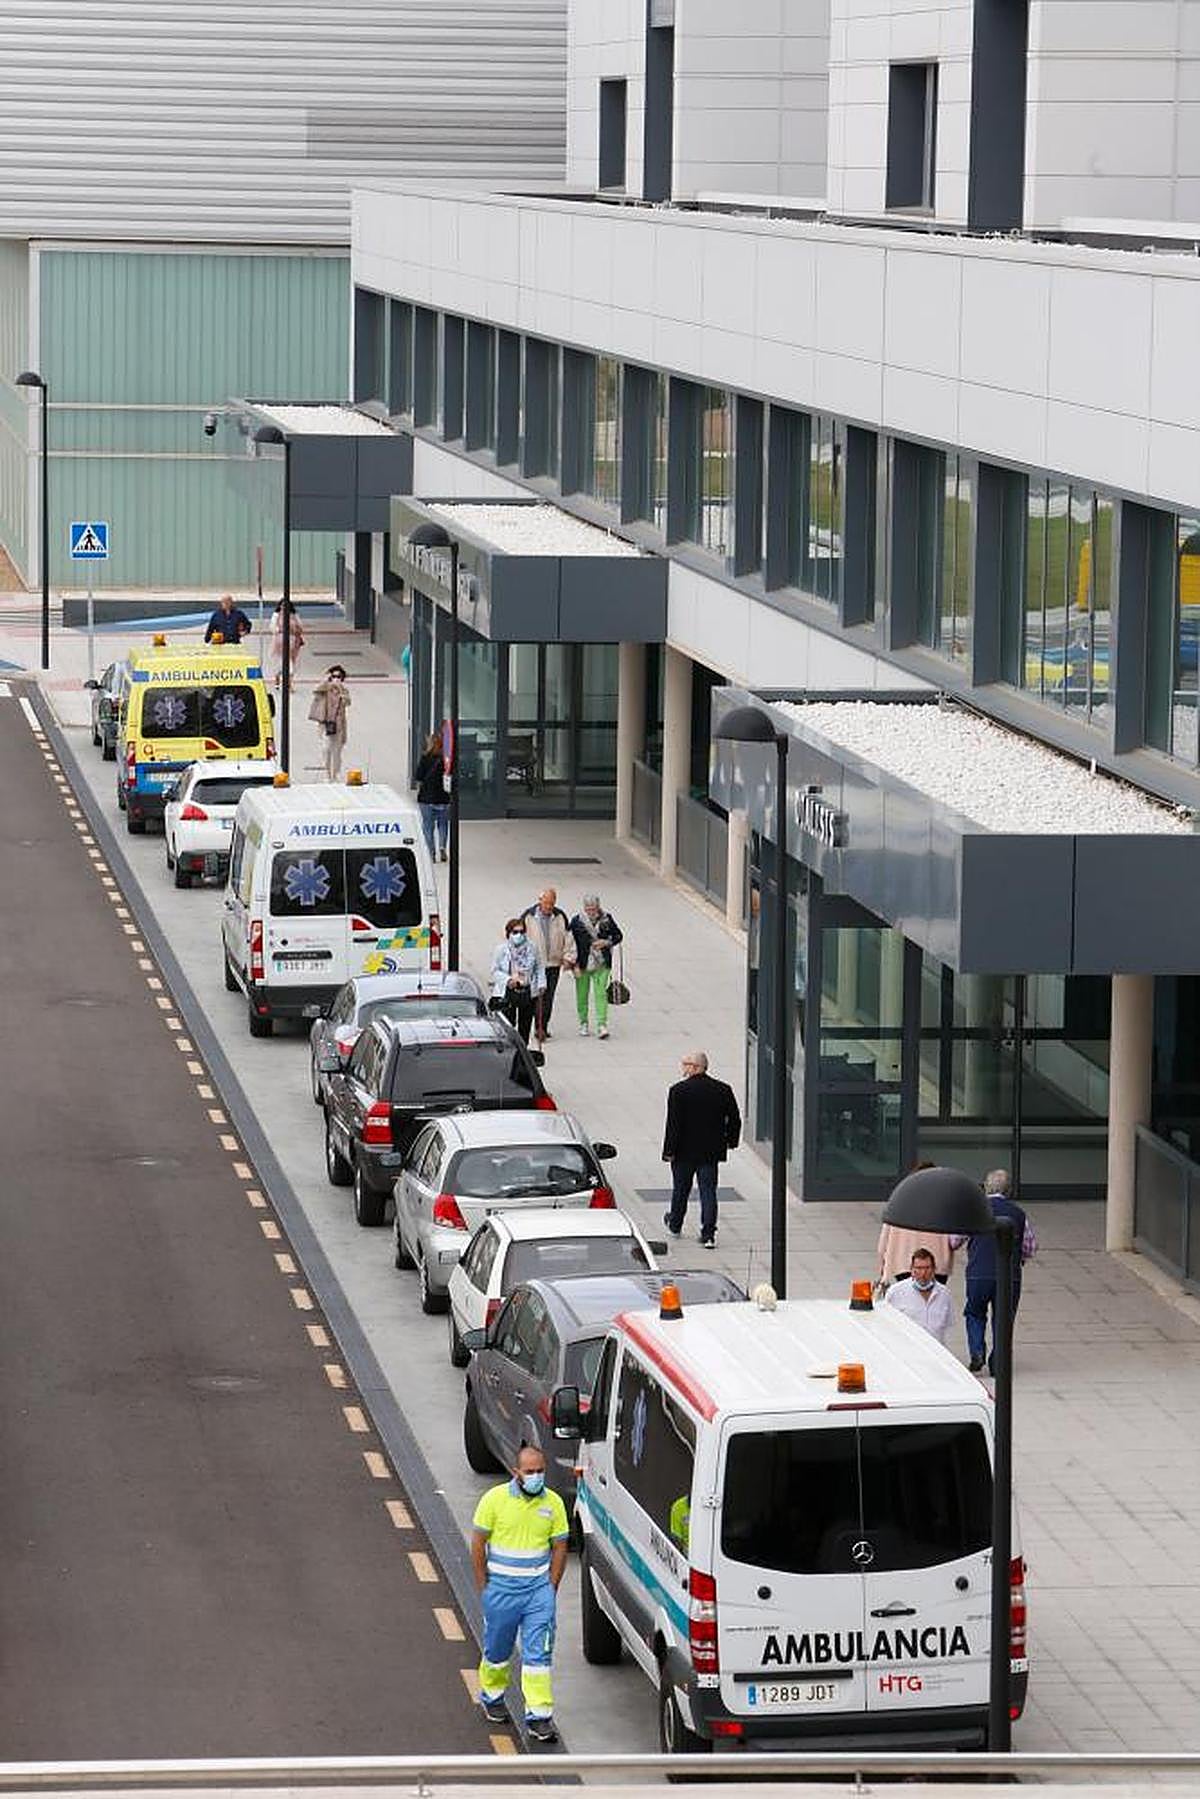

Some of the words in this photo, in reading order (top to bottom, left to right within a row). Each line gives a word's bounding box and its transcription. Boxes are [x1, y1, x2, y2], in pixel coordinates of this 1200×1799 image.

[151, 668, 244, 682] AMBULANCIA
[289, 822, 402, 836] AMBULANCIA
[760, 1625, 971, 1666] AMBULANCIA
[761, 1685, 801, 1703] 1289
[879, 1674, 923, 1696] HTG
